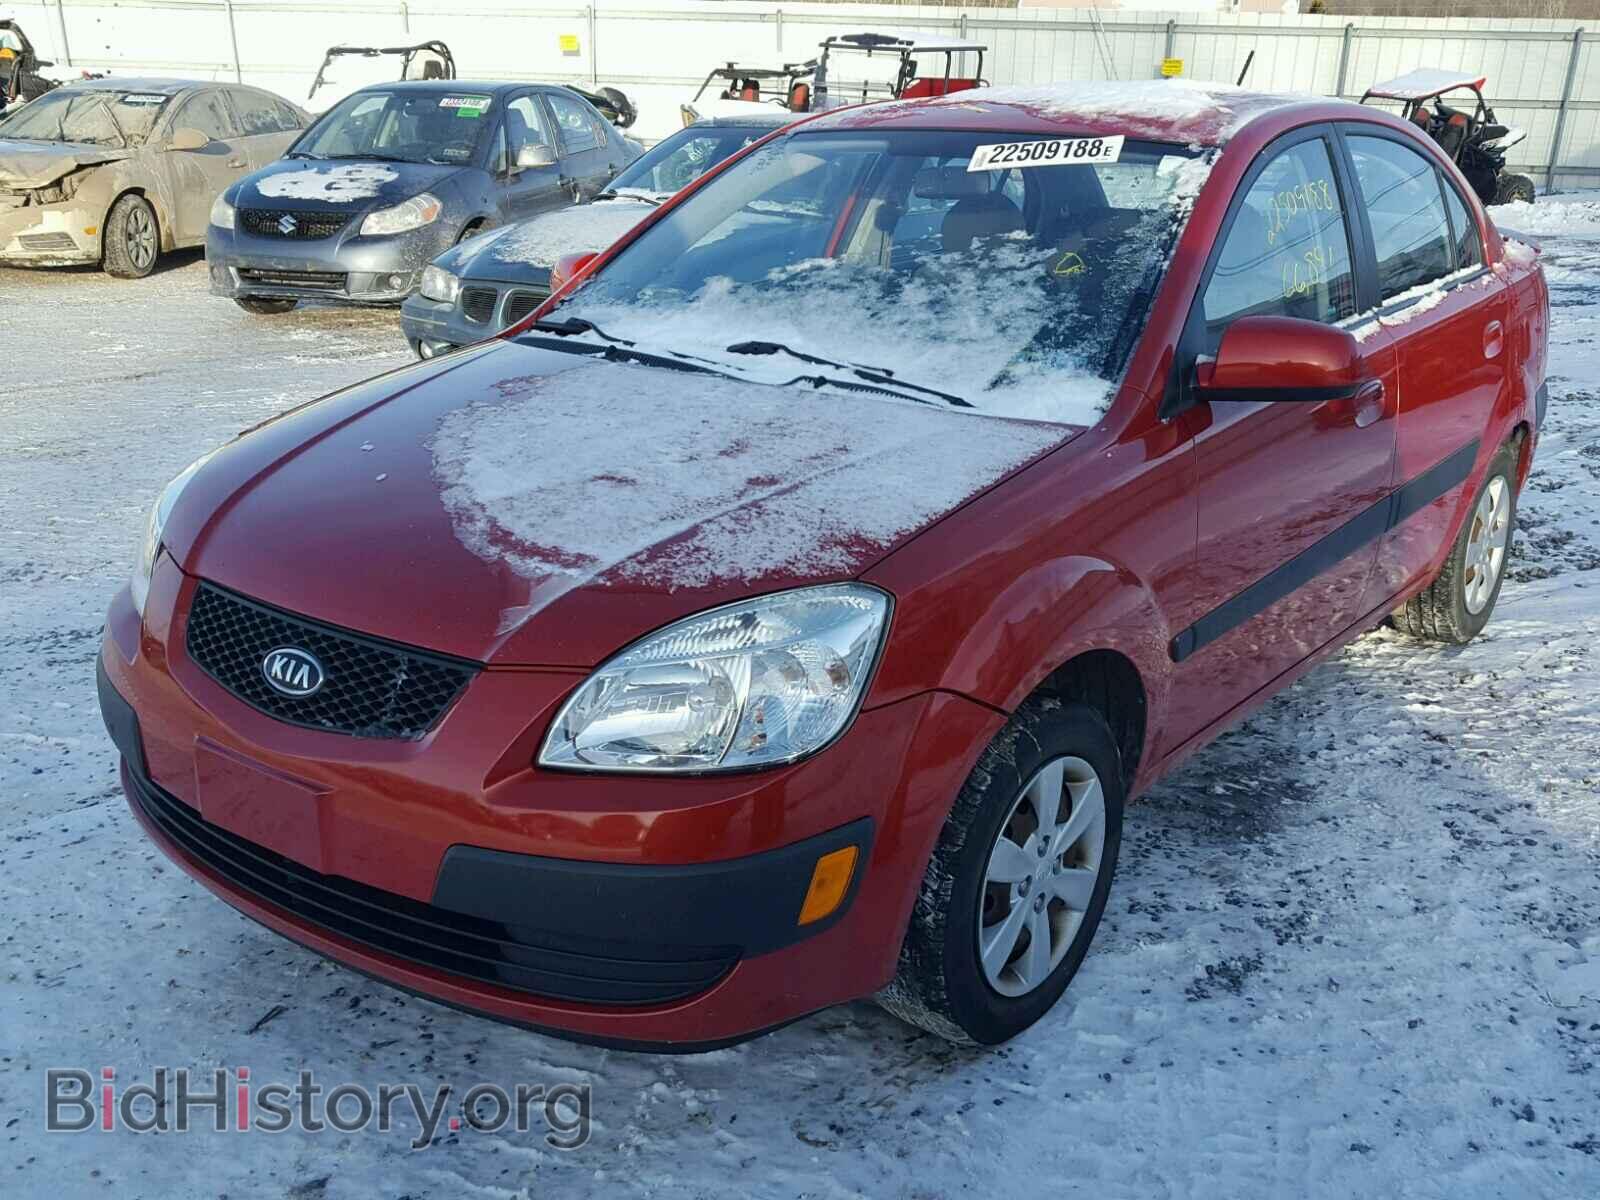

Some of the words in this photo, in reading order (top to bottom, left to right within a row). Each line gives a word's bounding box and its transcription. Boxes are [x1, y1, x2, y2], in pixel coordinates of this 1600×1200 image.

[988, 139, 1104, 164] 22509188
[1103, 145, 1114, 157] E
[270, 654, 310, 689] KIA
